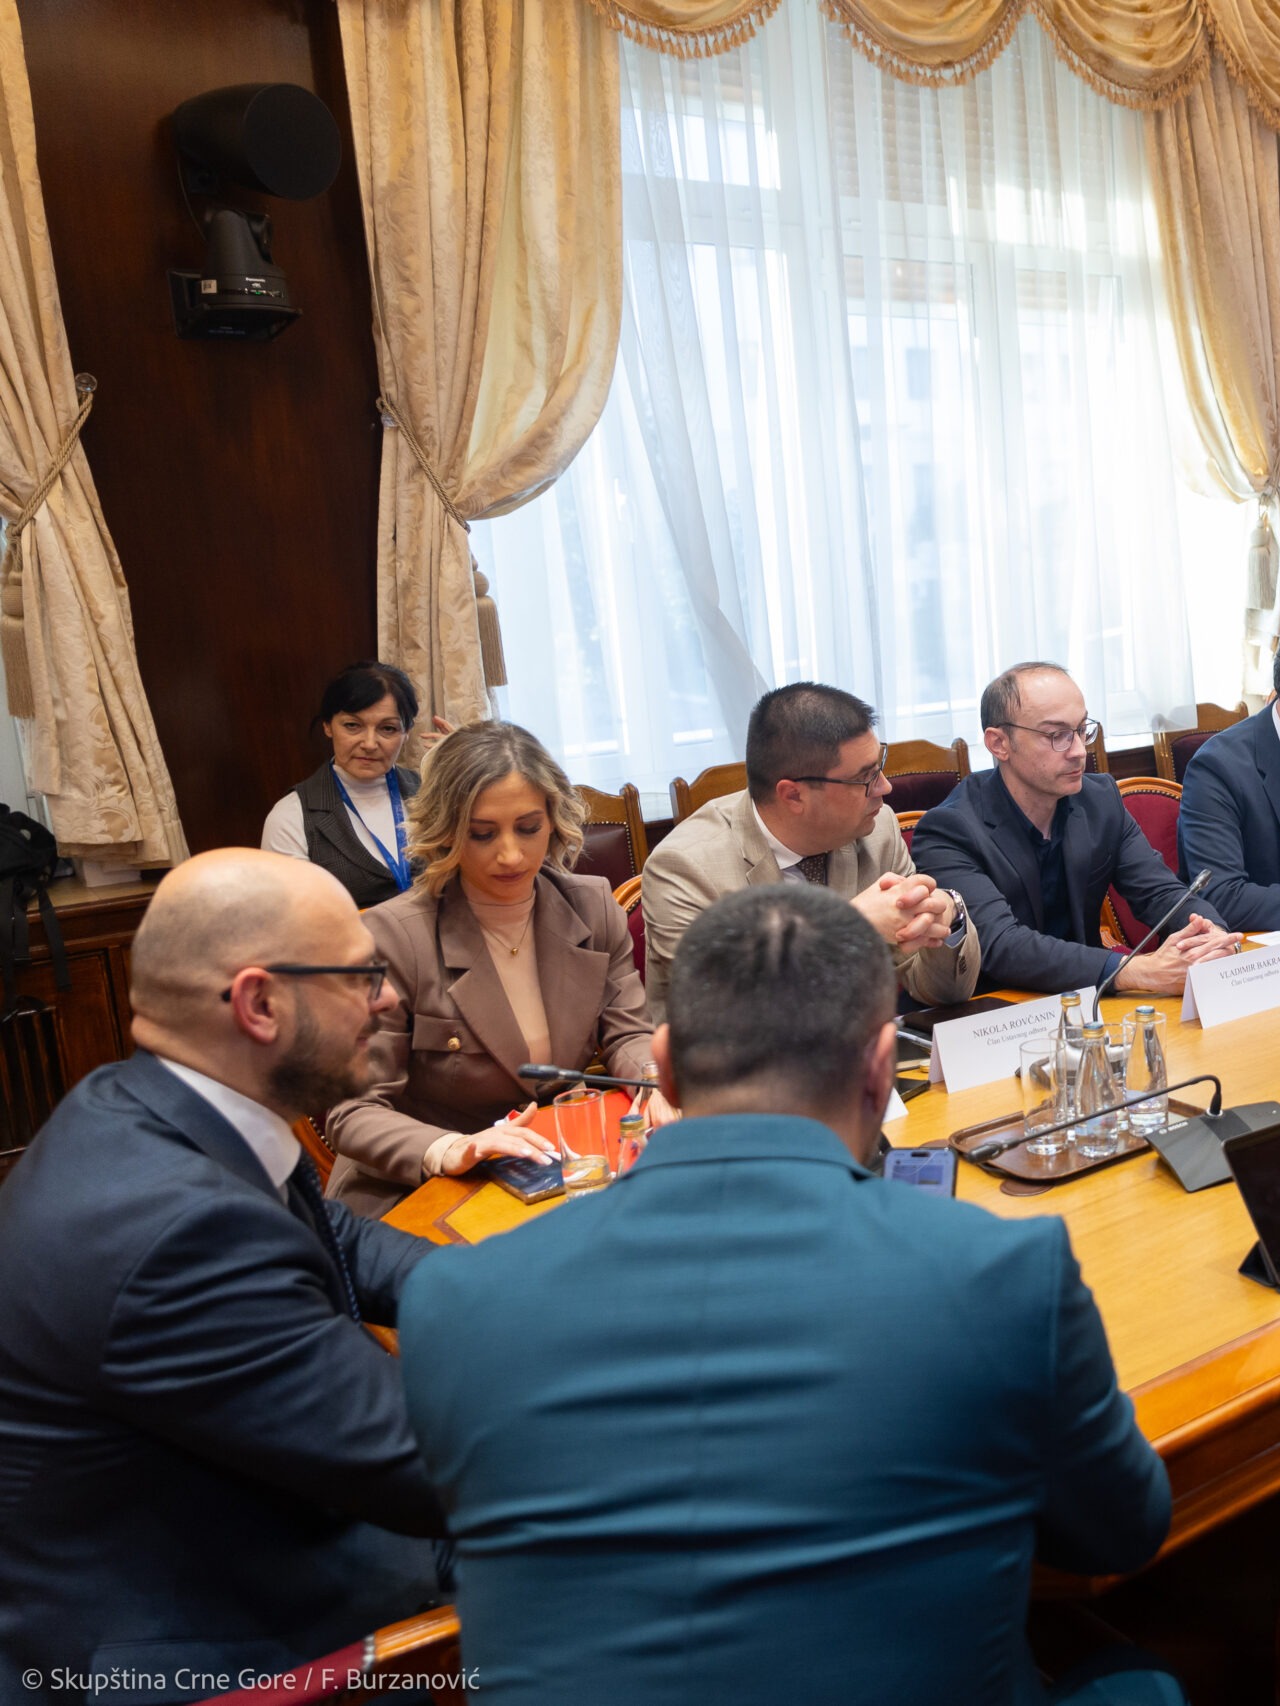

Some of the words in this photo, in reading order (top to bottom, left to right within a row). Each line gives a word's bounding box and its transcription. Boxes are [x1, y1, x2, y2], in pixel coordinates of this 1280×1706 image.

[1219, 963, 1255, 979] VLADIMIR
[972, 1023, 1008, 1039] NIKOLA
[1009, 1010, 1056, 1030] ROVČANIN
